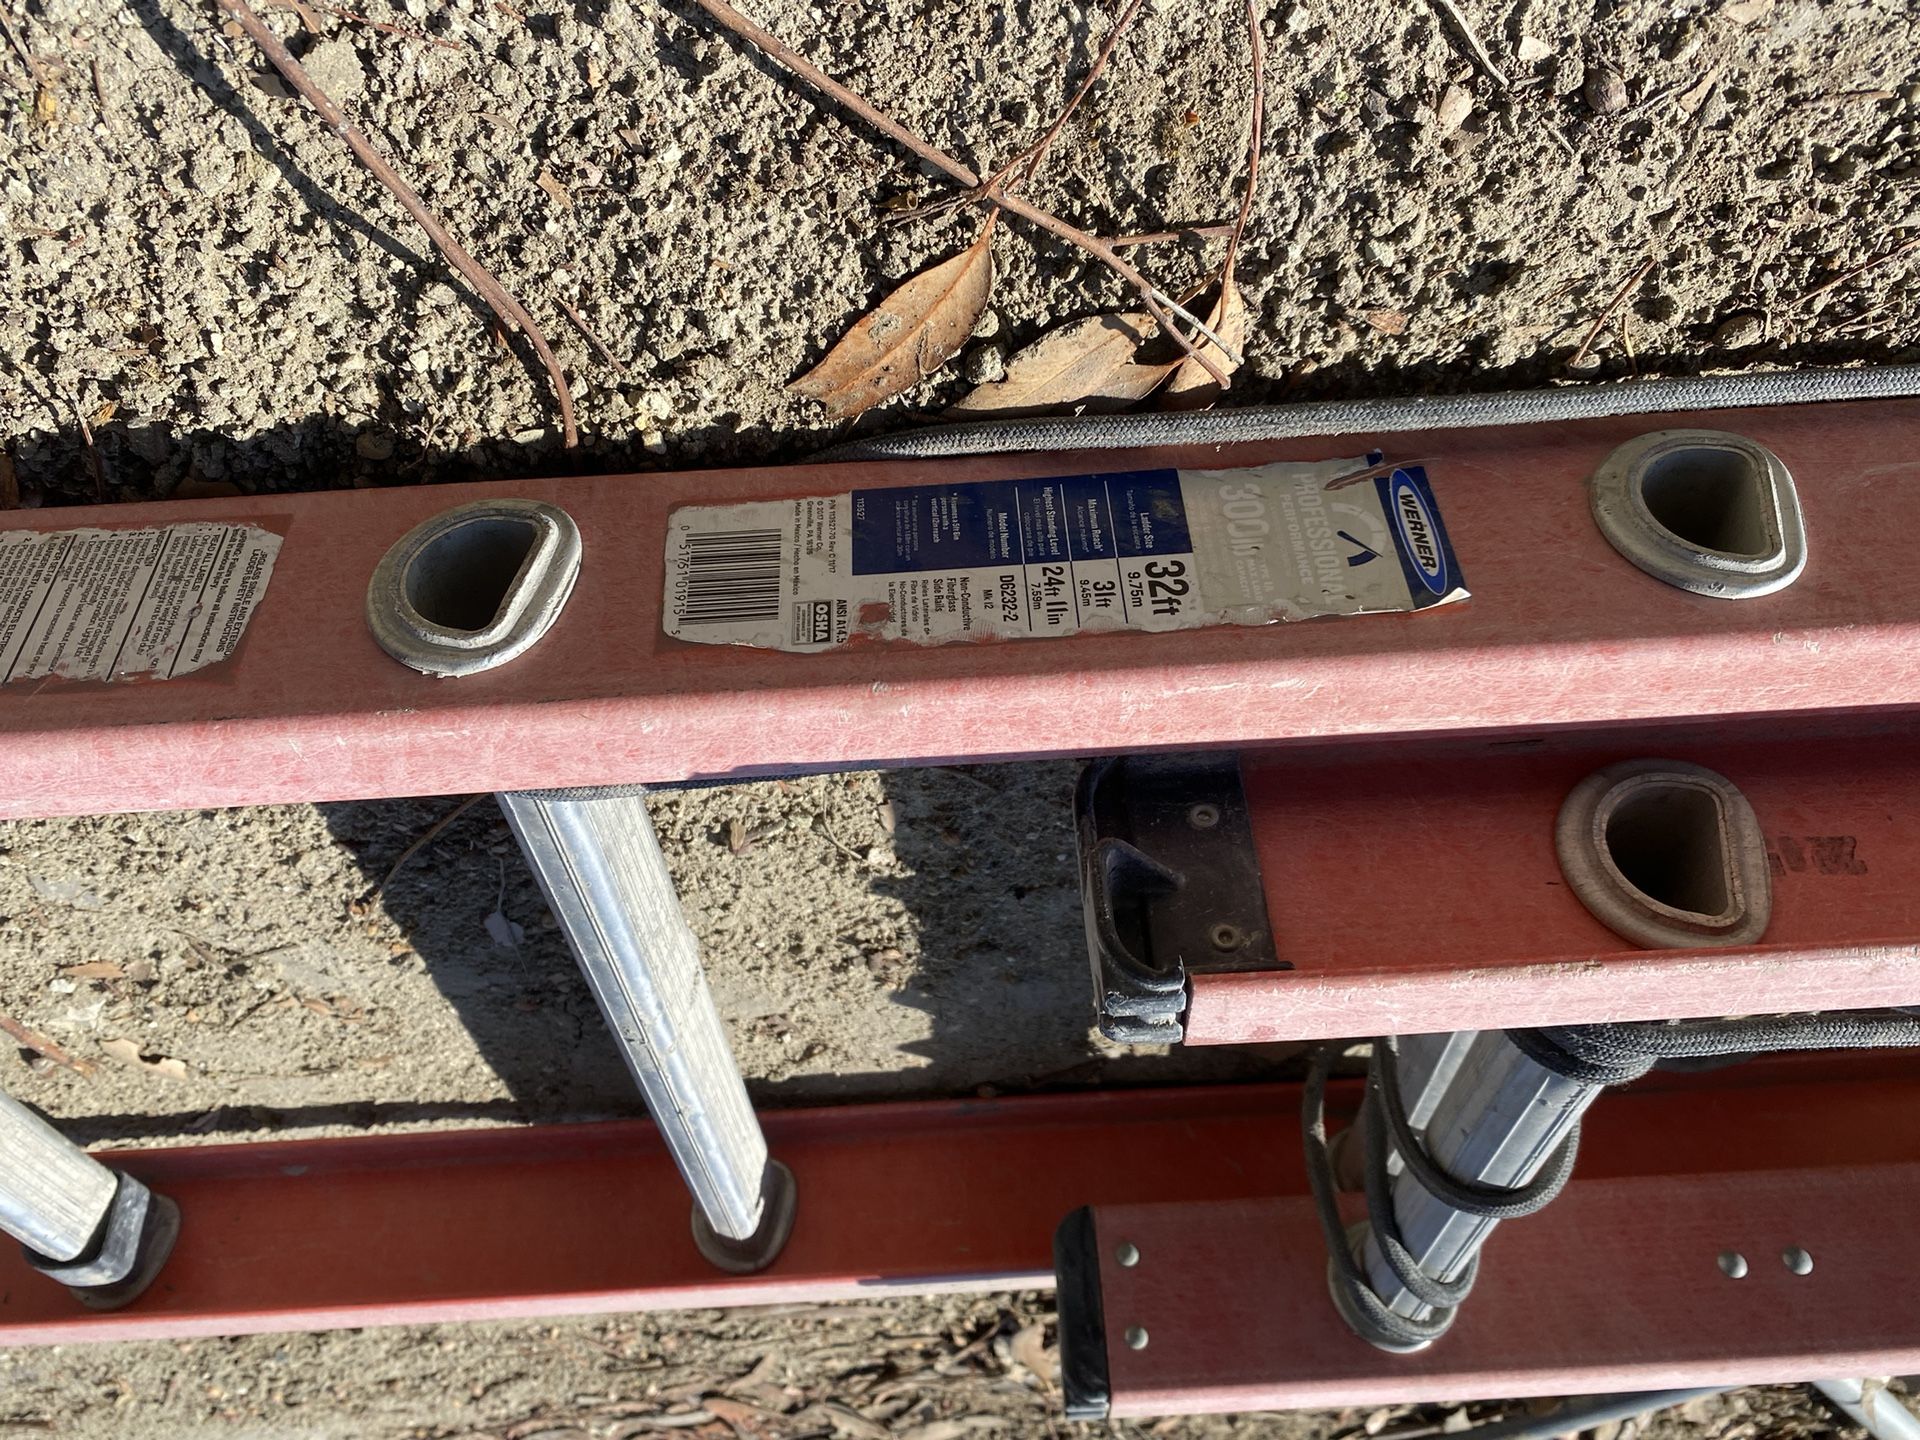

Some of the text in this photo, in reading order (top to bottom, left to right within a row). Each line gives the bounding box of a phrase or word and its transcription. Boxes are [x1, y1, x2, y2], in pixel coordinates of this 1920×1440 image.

[856, 498, 865, 520] 113527
[986, 509, 995, 530] Número
[1024, 512, 1032, 539] colocarse
[1042, 487, 1060, 555] Highest Standing Level
[1077, 506, 1085, 527] Alcance
[1087, 499, 1100, 529] Maximum
[1126, 490, 1137, 510] Tamaño
[1132, 525, 1141, 549] escalera
[1219, 483, 1270, 556] 300lb
[206, 534, 220, 551] READ
[998, 513, 1010, 559] Model Number
[1140, 512, 1154, 548] Ladder Size
[1280, 494, 1314, 584] PERFORMANCE
[1292, 473, 1346, 604] PROFESSIONAL
[1400, 494, 1437, 568] WERNER
[201, 552, 213, 563] ALL
[677, 544, 690, 575] 51751
[988, 539, 996, 559] modelo
[241, 581, 257, 605] SINGLE
[933, 579, 943, 612] Side Rails
[946, 578, 958, 612] Fiberglass
[983, 589, 993, 600] Mk
[1031, 583, 1042, 610] 7.59m
[1042, 566, 1068, 624] 24ft 11in
[1080, 579, 1090, 606] 9.45m
[1093, 581, 1116, 608] 31ft
[1128, 572, 1144, 607] 9.75m
[1145, 560, 1190, 615] 32ft
[1236, 560, 1250, 598] CAPACITY
[1248, 559, 1263, 602] MAX LOAD
[215, 548, 260, 652] LADDER SAFETY INSTRUCTIONS
[235, 606, 248, 620] AND
[674, 582, 688, 615] 01915
[899, 581, 907, 628] No-Conductores
[960, 577, 972, 630] Non-Conductive
[999, 575, 1018, 622] D6232-2
[815, 604, 828, 641] OSHA
[836, 600, 848, 643] ANSI A14.5
